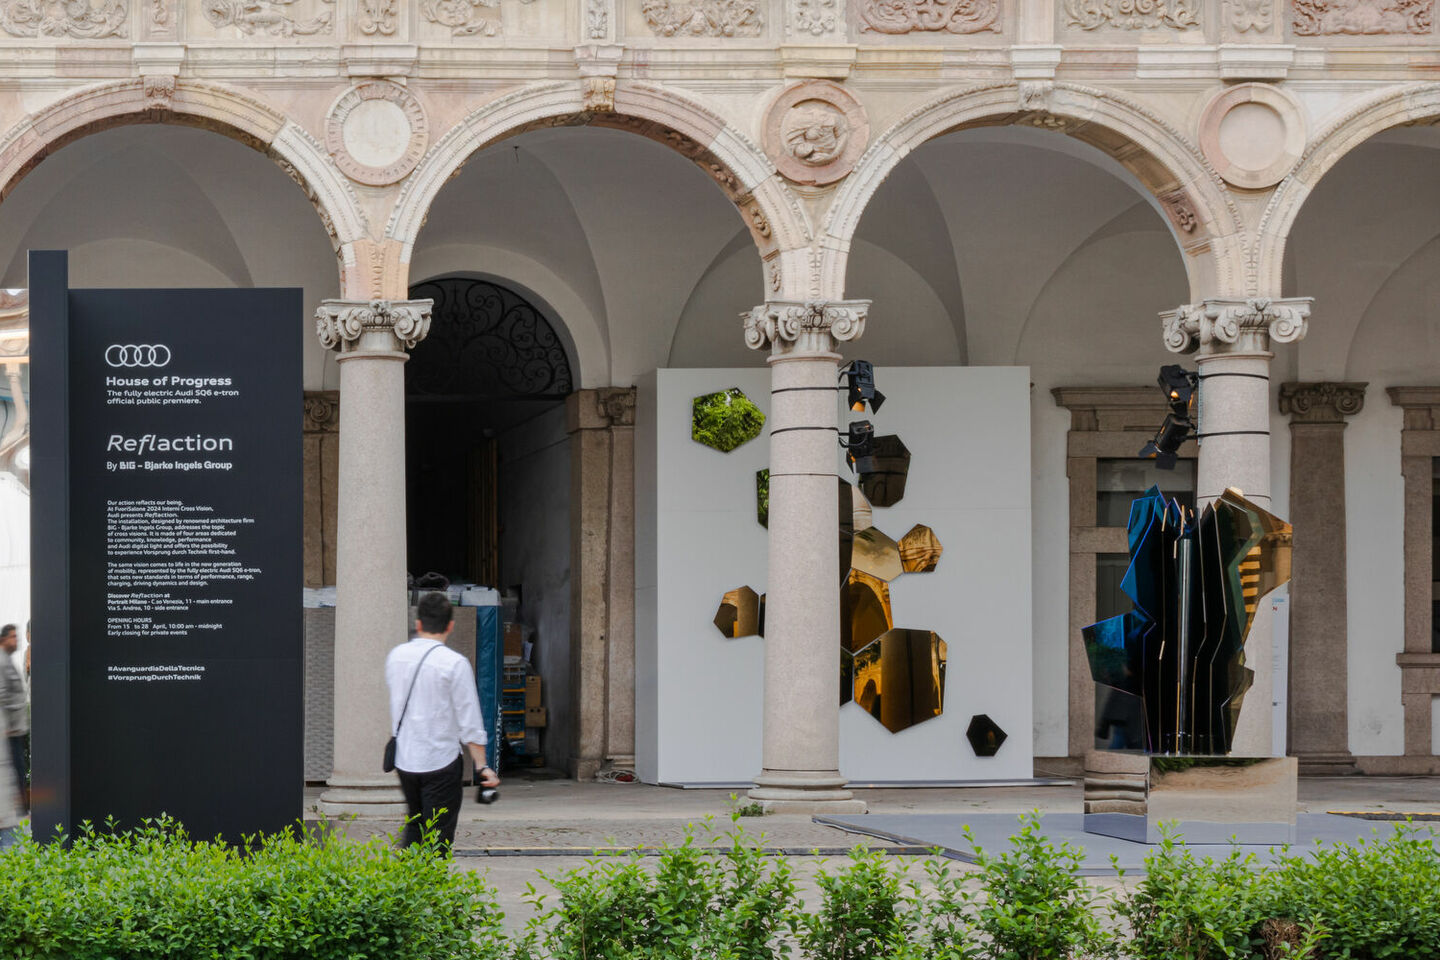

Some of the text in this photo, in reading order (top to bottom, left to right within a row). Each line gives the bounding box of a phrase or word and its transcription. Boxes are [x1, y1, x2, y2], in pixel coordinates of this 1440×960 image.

[106, 377, 232, 387] House of Progress
[107, 434, 233, 455] Reflaction
[106, 462, 118, 471] By
[144, 462, 174, 471] Bjarke
[174, 462, 203, 471] Ingels
[203, 462, 233, 471] Group
